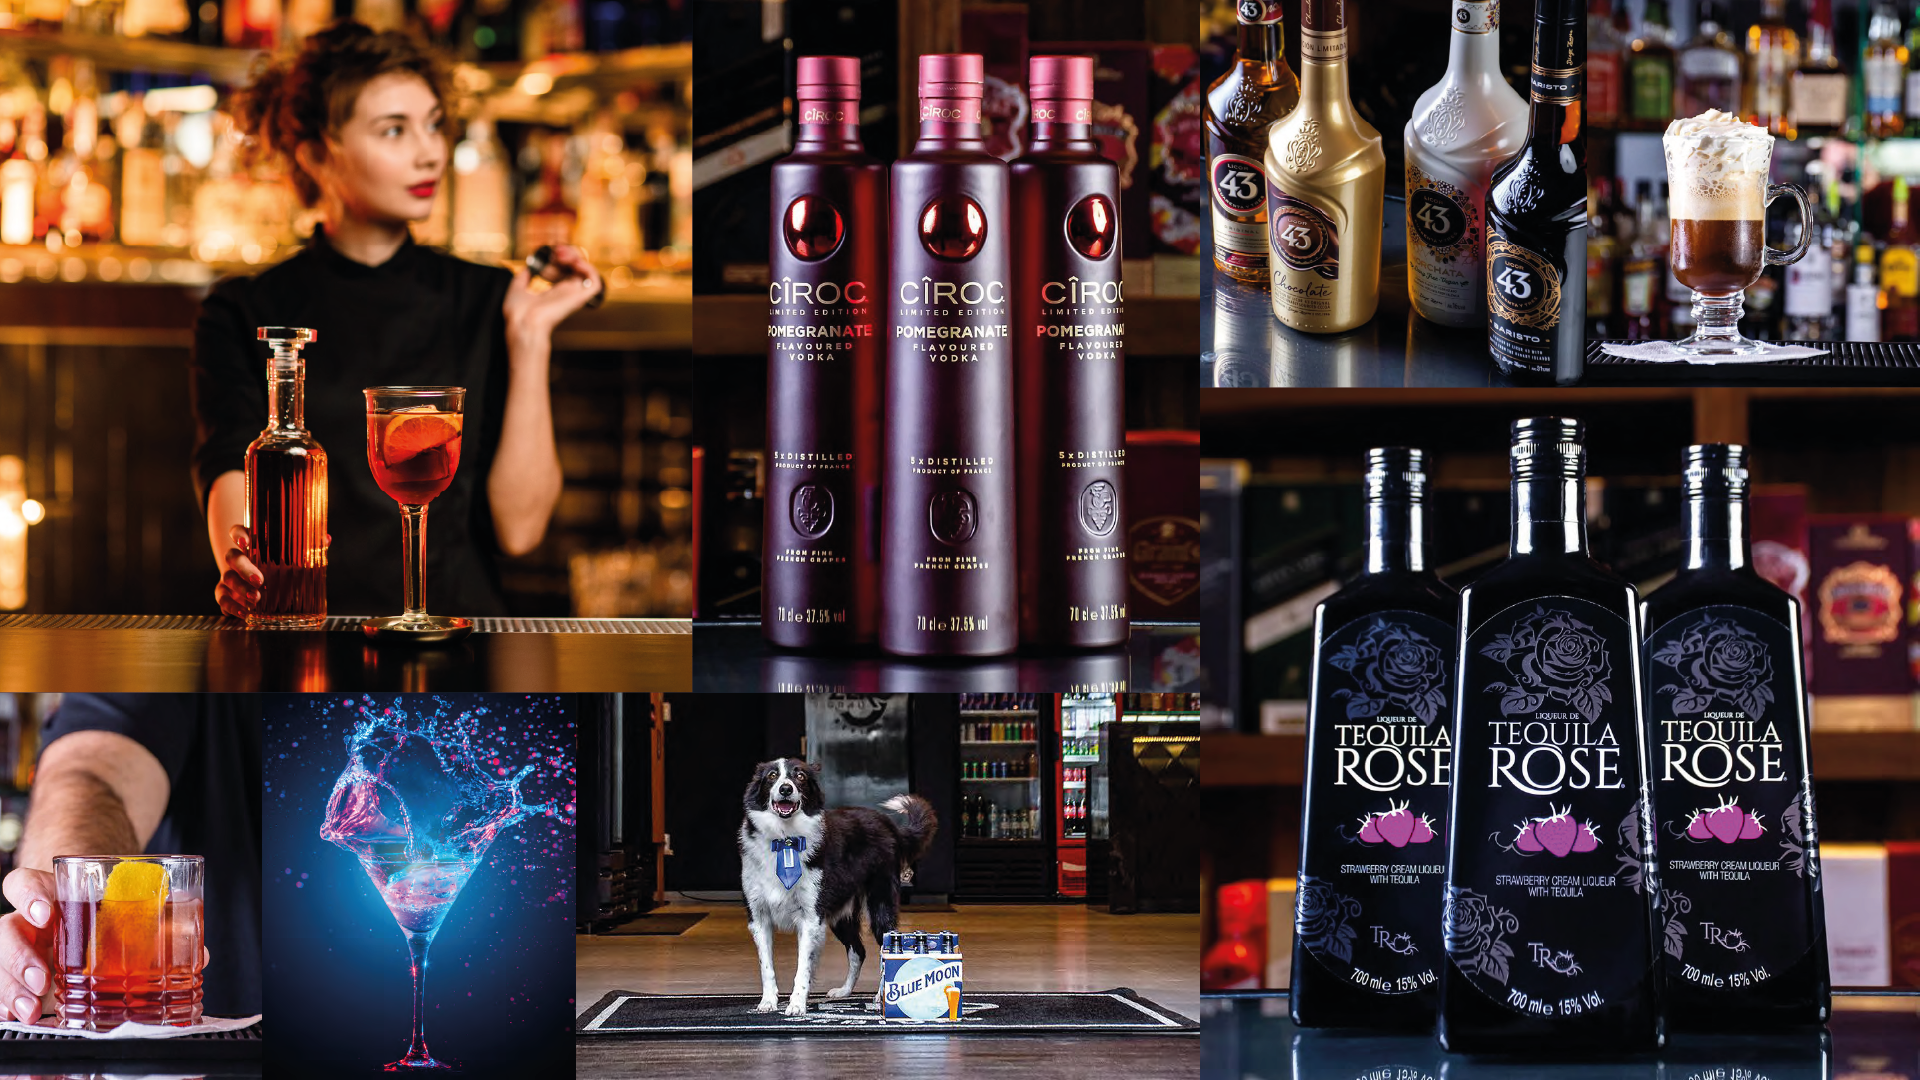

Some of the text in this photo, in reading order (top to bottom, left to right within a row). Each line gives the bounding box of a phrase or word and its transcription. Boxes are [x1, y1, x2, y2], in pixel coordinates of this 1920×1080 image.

[1240, 1, 1258, 17] 43
[1457, 10, 1467, 20] 43
[804, 108, 844, 121] CÎROC
[921, 105, 961, 119] CÎROC
[1034, 109, 1056, 120] ROC
[1219, 170, 1259, 200] 43
[1416, 201, 1451, 234] 43
[1281, 224, 1312, 250] 43
[1415, 257, 1465, 278] ORCHATA
[1273, 270, 1333, 298] Chocolate
[1496, 266, 1532, 299] 43
[769, 276, 868, 305] CÎROC
[900, 276, 1005, 305] CÎROC
[769, 308, 867, 316] LIMITED EDITION
[958, 308, 1005, 316] EDITION
[1041, 307, 1124, 316] LIMITED EDITI
[768, 324, 872, 338] POMEGRANATE
[896, 324, 1008, 339] POMEGRANATE
[1036, 323, 1125, 338] POMEGRANAT
[1493, 321, 1541, 344] BARISTO
[776, 342, 853, 351] FLAVOURED
[913, 343, 994, 352] FLAVOURED
[1059, 341, 1123, 350] FLAVOURED
[789, 353, 835, 361] VODKA
[929, 354, 979, 362] VODKA
[1077, 351, 1116, 360] VODKA
[787, 452, 853, 461] DISTILLED
[1077, 449, 1126, 459] DISTILLED
[927, 457, 994, 466] DISTILLED
[833, 607, 846, 623] vol
[1069, 606, 1080, 622] 70
[917, 615, 926, 631] 70
[977, 614, 988, 631] vol
[1376, 716, 1407, 724] LIQUEUR
[1535, 712, 1568, 720] LIQUEUR
[1703, 711, 1734, 719] LIQUEUR
[1334, 724, 1452, 754] TEQUILA
[1488, 721, 1620, 754] TEQUILA
[1660, 720, 1781, 750] TEQUILA
[1333, 747, 1452, 792] ROSE
[1487, 746, 1624, 795] ROSE
[1660, 743, 1786, 788] ROSE
[1340, 864, 1445, 875] STRAWBERRY CREAM LIQUEU
[1669, 860, 1780, 871] STRAWBERRY CREAM LIQUEUR
[1369, 875, 1420, 885] WITH TEQUILA
[1495, 874, 1617, 887] STRAWBERRY CREAM LIQUEUR
[1699, 870, 1751, 881] WITH TEQUILA
[1528, 886, 1584, 898] WITH TEQUILA
[1350, 967, 1370, 986] 700
[1396, 975, 1418, 991] 15%
[1417, 968, 1439, 986] Vol.
[1681, 963, 1701, 982] 700
[1728, 971, 1751, 988] 15%
[1749, 965, 1771, 983] Vol.
[886, 965, 960, 1002] BLUE MOON
[1507, 988, 1528, 1009] 700
[1558, 996, 1582, 1016] 15%
[1581, 990, 1605, 1010] Vol.
